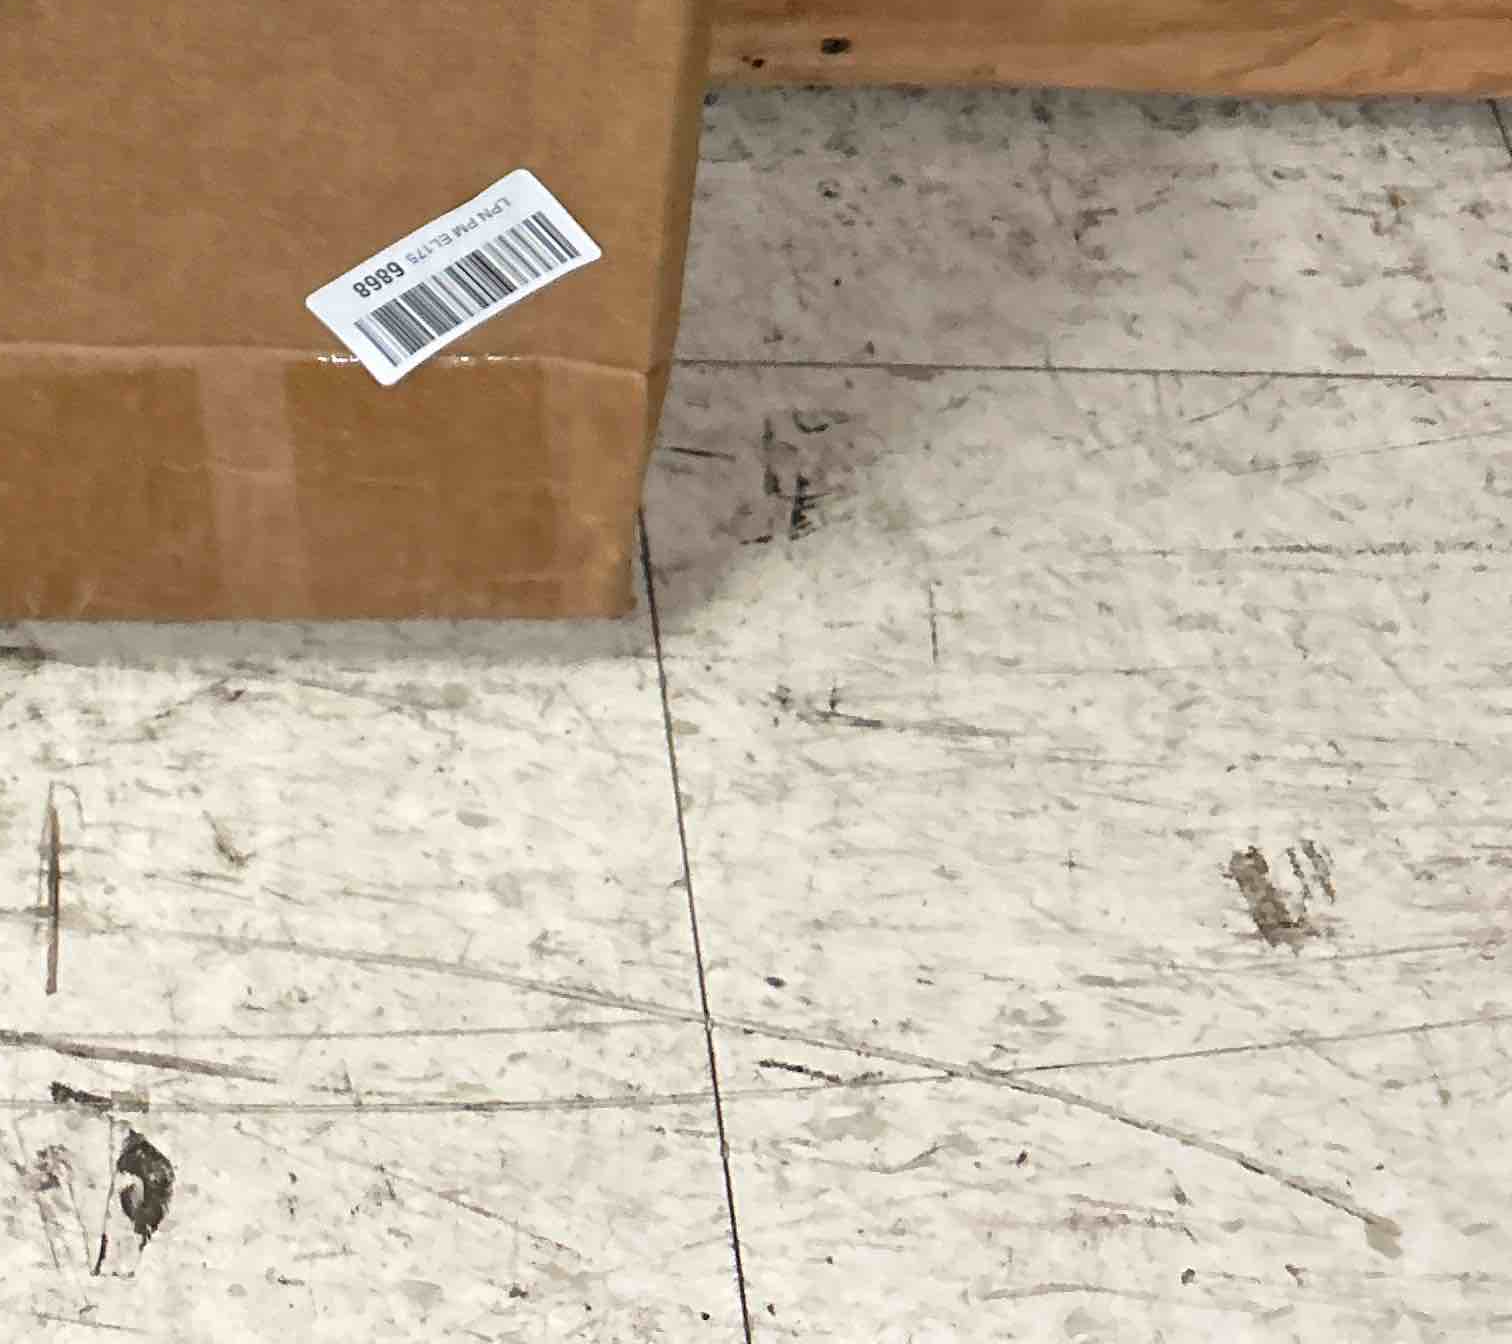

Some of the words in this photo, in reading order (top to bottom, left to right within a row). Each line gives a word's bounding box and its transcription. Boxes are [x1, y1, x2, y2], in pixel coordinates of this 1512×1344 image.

[476, 196, 511, 222] LPN
[452, 217, 479, 237] PM
[353, 262, 405, 298] 6868
